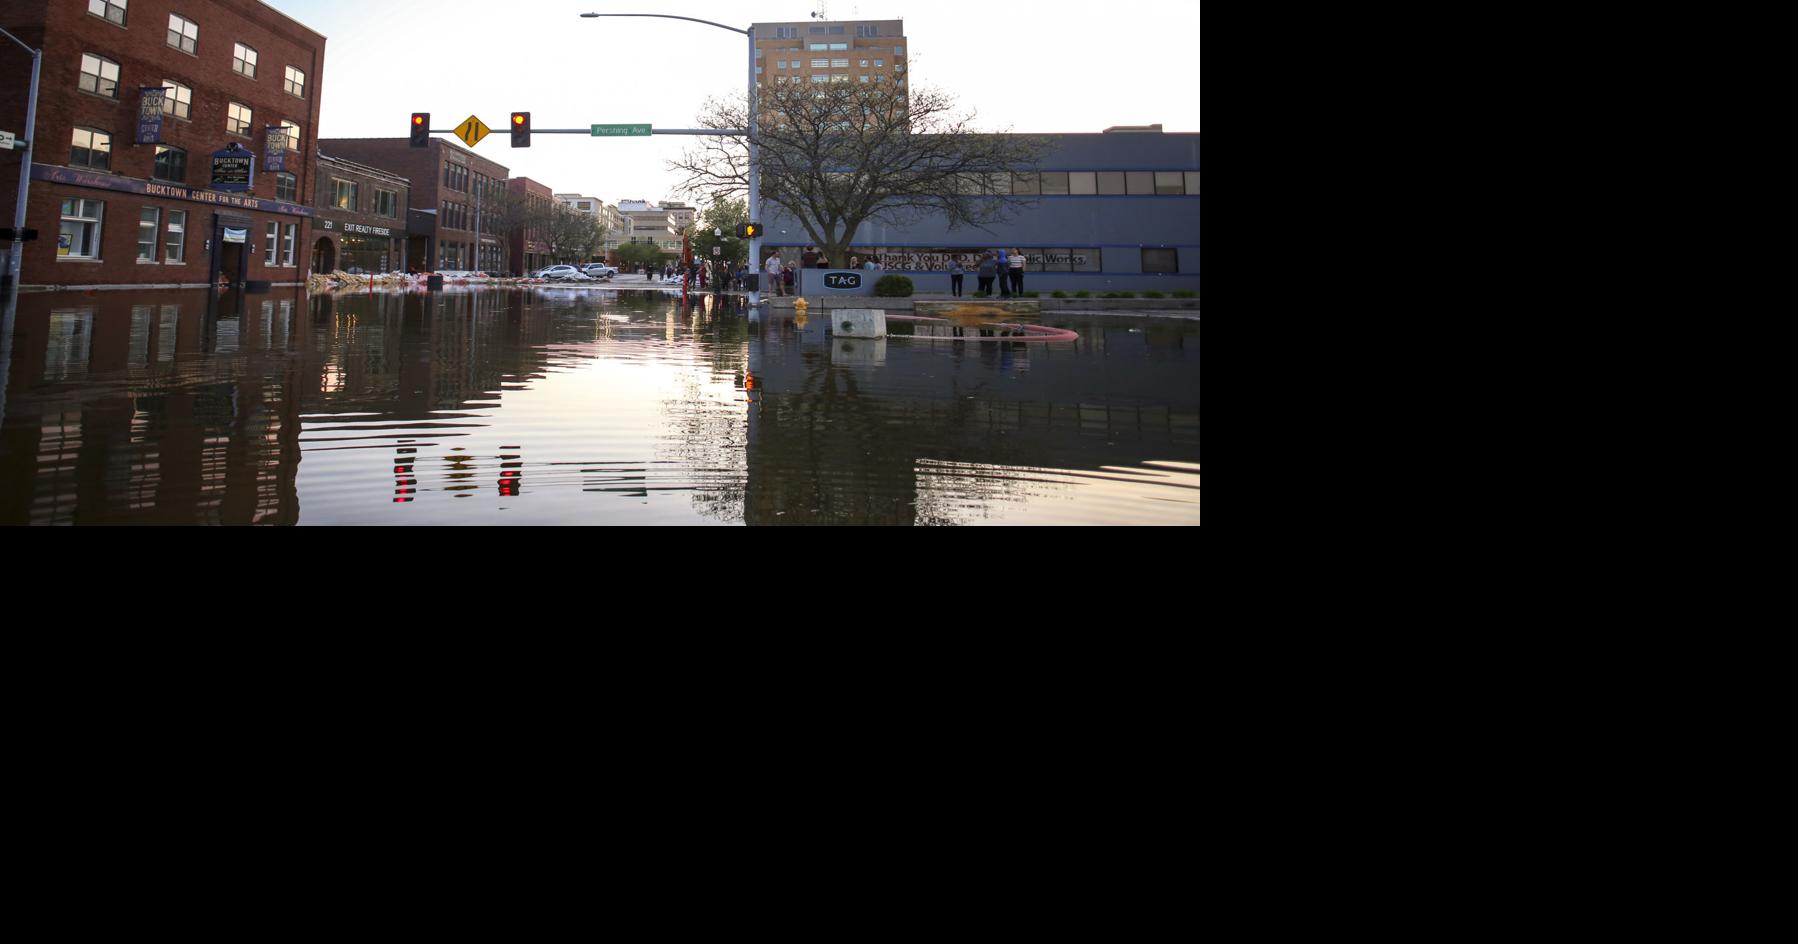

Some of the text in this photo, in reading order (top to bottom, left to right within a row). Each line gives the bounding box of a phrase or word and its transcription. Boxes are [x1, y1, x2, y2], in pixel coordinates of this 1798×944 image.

[142, 96, 165, 106] BUCK
[596, 127, 628, 135] Pershing
[214, 157, 249, 166] BUCKTOWN
[146, 183, 187, 198] BUCKTOWN
[191, 190, 216, 202] CENTER
[231, 197, 241, 205] THE
[243, 199, 259, 208] ARTS
[324, 220, 333, 229] 221
[344, 222, 390, 236] EXIT REALTY FIRESIDE
[879, 253, 914, 262] Thank
[916, 253, 939, 262] You
[829, 276, 856, 285] TAG
